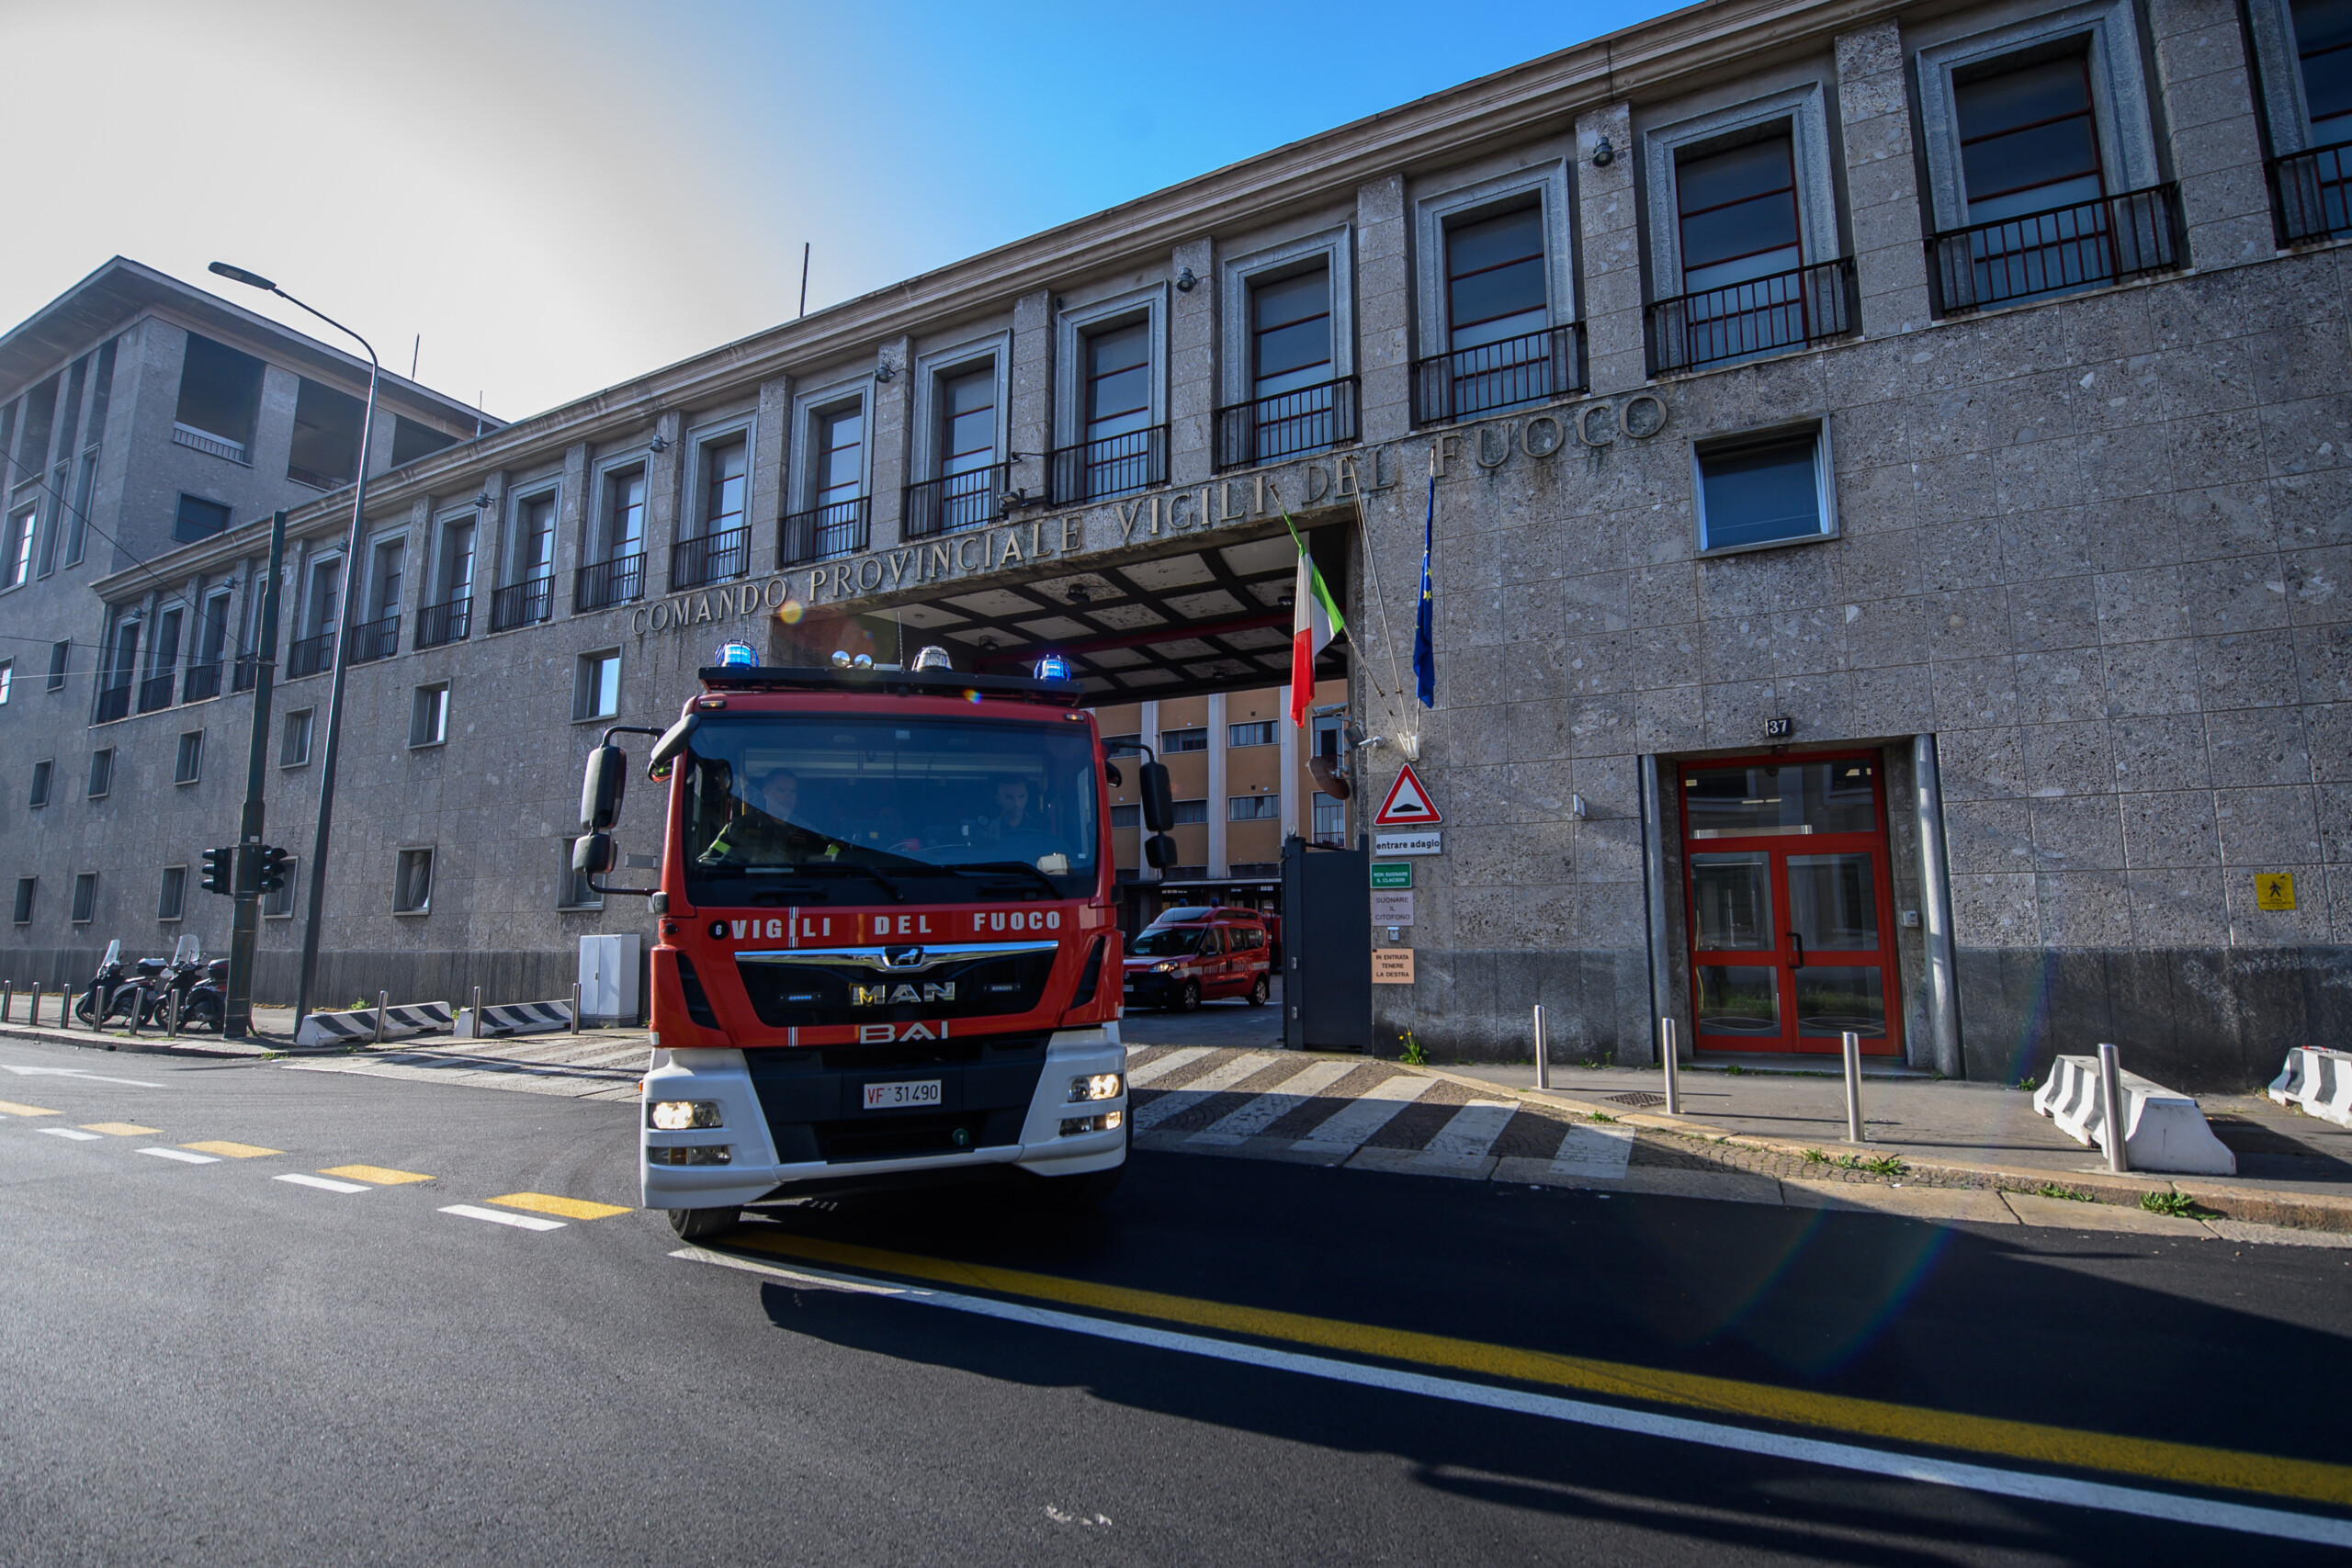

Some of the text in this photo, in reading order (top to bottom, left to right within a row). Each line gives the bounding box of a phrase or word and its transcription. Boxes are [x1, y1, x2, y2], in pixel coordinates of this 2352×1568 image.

[631, 395, 1668, 635] COMANDO PROVINCIALE VIGILI DEL FUOCO
[1770, 719, 1787, 734] 37
[1376, 839, 1440, 850] entrare adagio
[715, 925, 723, 936] 6
[731, 911, 1060, 940] VIGILI DEL FUOCO
[852, 982, 956, 1006] MAN
[860, 1021, 948, 1044] BAI
[867, 1085, 939, 1104] VF 31490
